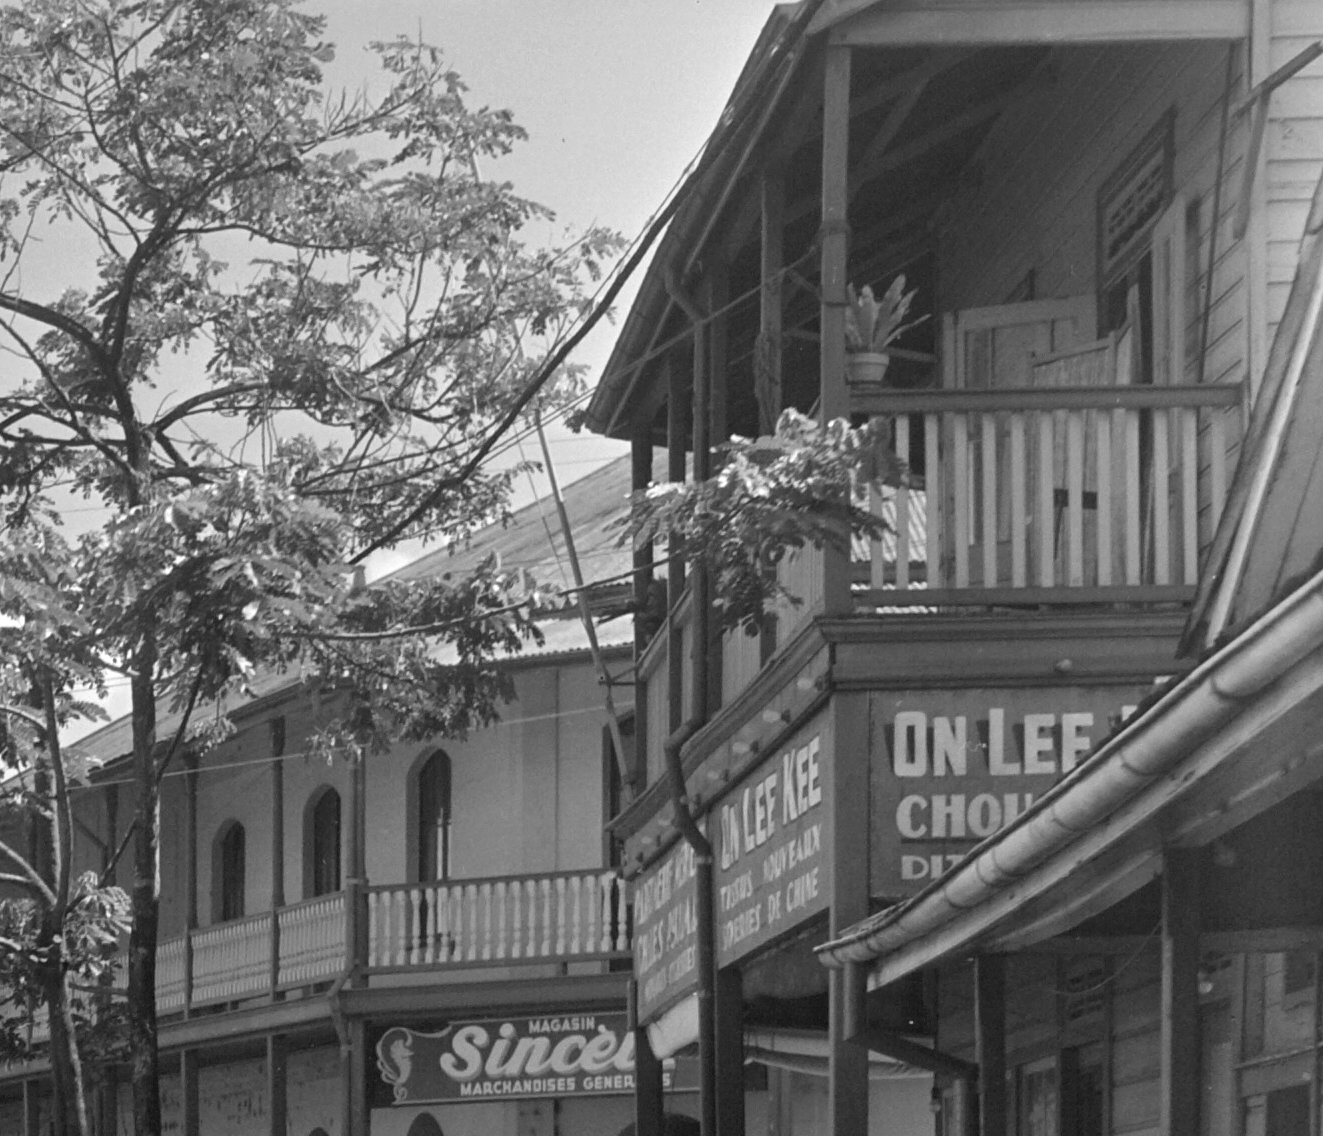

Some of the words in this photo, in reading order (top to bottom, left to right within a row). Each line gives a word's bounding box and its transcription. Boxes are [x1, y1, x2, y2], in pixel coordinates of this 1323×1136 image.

[894, 711, 966, 777] ON
[989, 707, 1094, 776] LEE
[721, 803, 740, 871] ON
[742, 772, 778, 854] LEE
[782, 735, 822, 826] KEE
[767, 890, 781, 925] DE
[786, 866, 819, 914] CHINE
[529, 1016, 596, 1034] MAGASIN
[460, 1077, 576, 1096] MARCHANDISES
